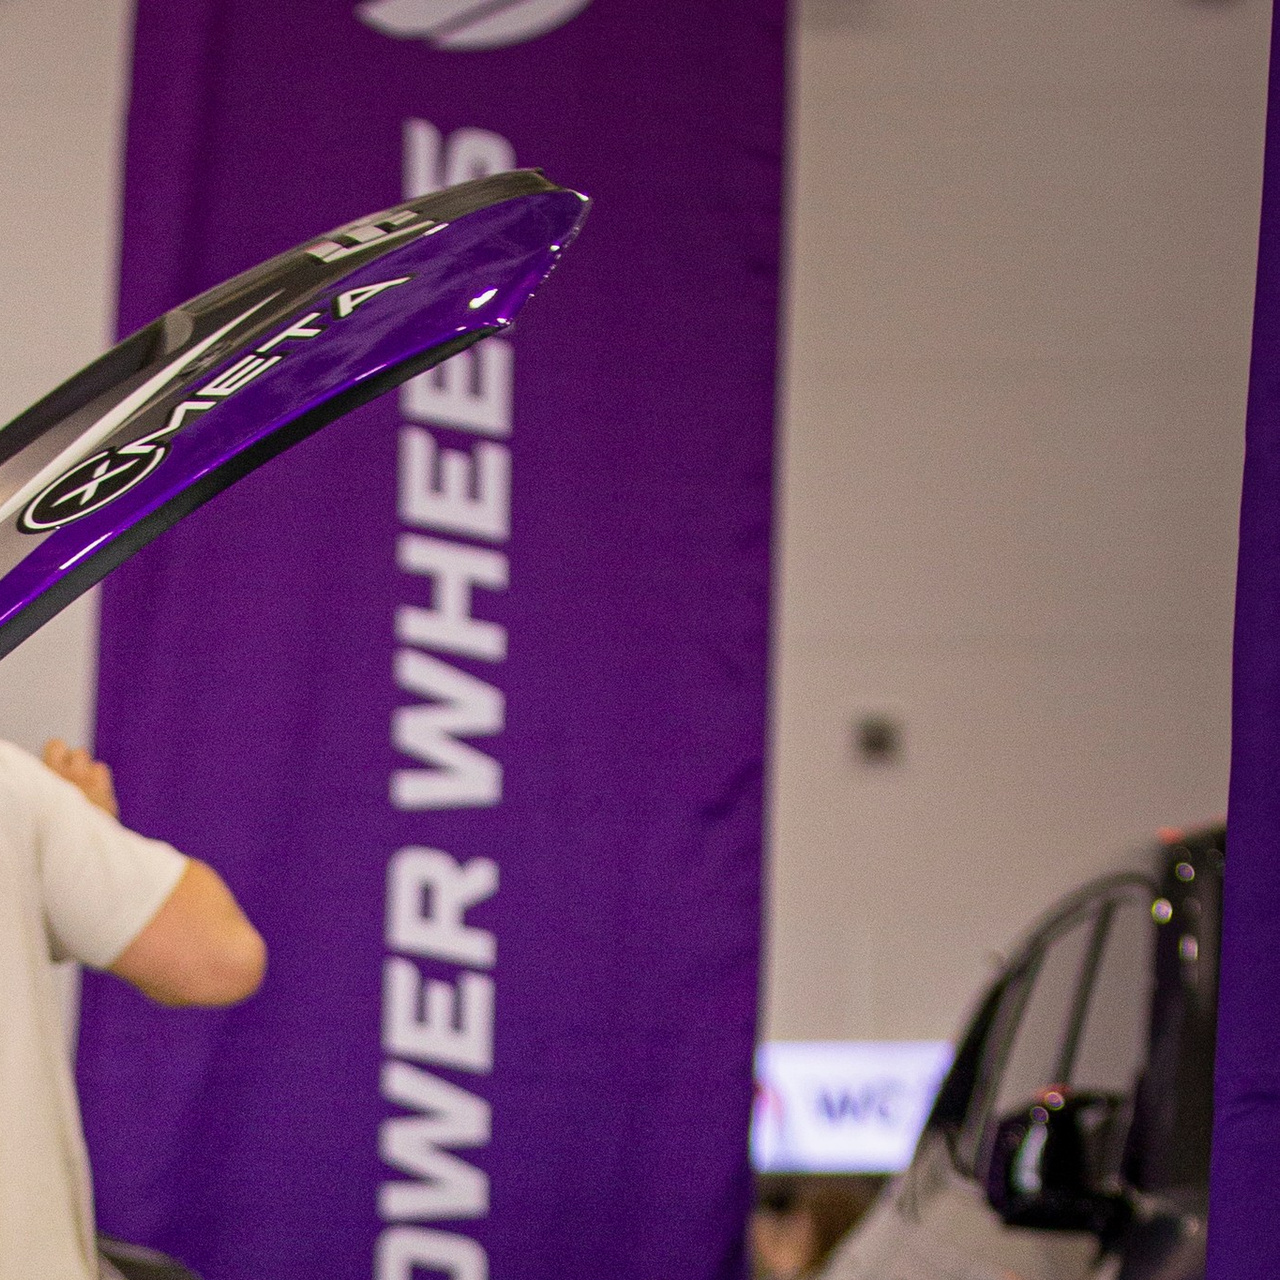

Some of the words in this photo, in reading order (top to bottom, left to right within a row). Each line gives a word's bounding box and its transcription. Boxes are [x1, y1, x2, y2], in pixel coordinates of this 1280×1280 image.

[117, 275, 412, 455] META
[388, 117, 517, 811] WHEES
[817, 1076, 907, 1124] WC
